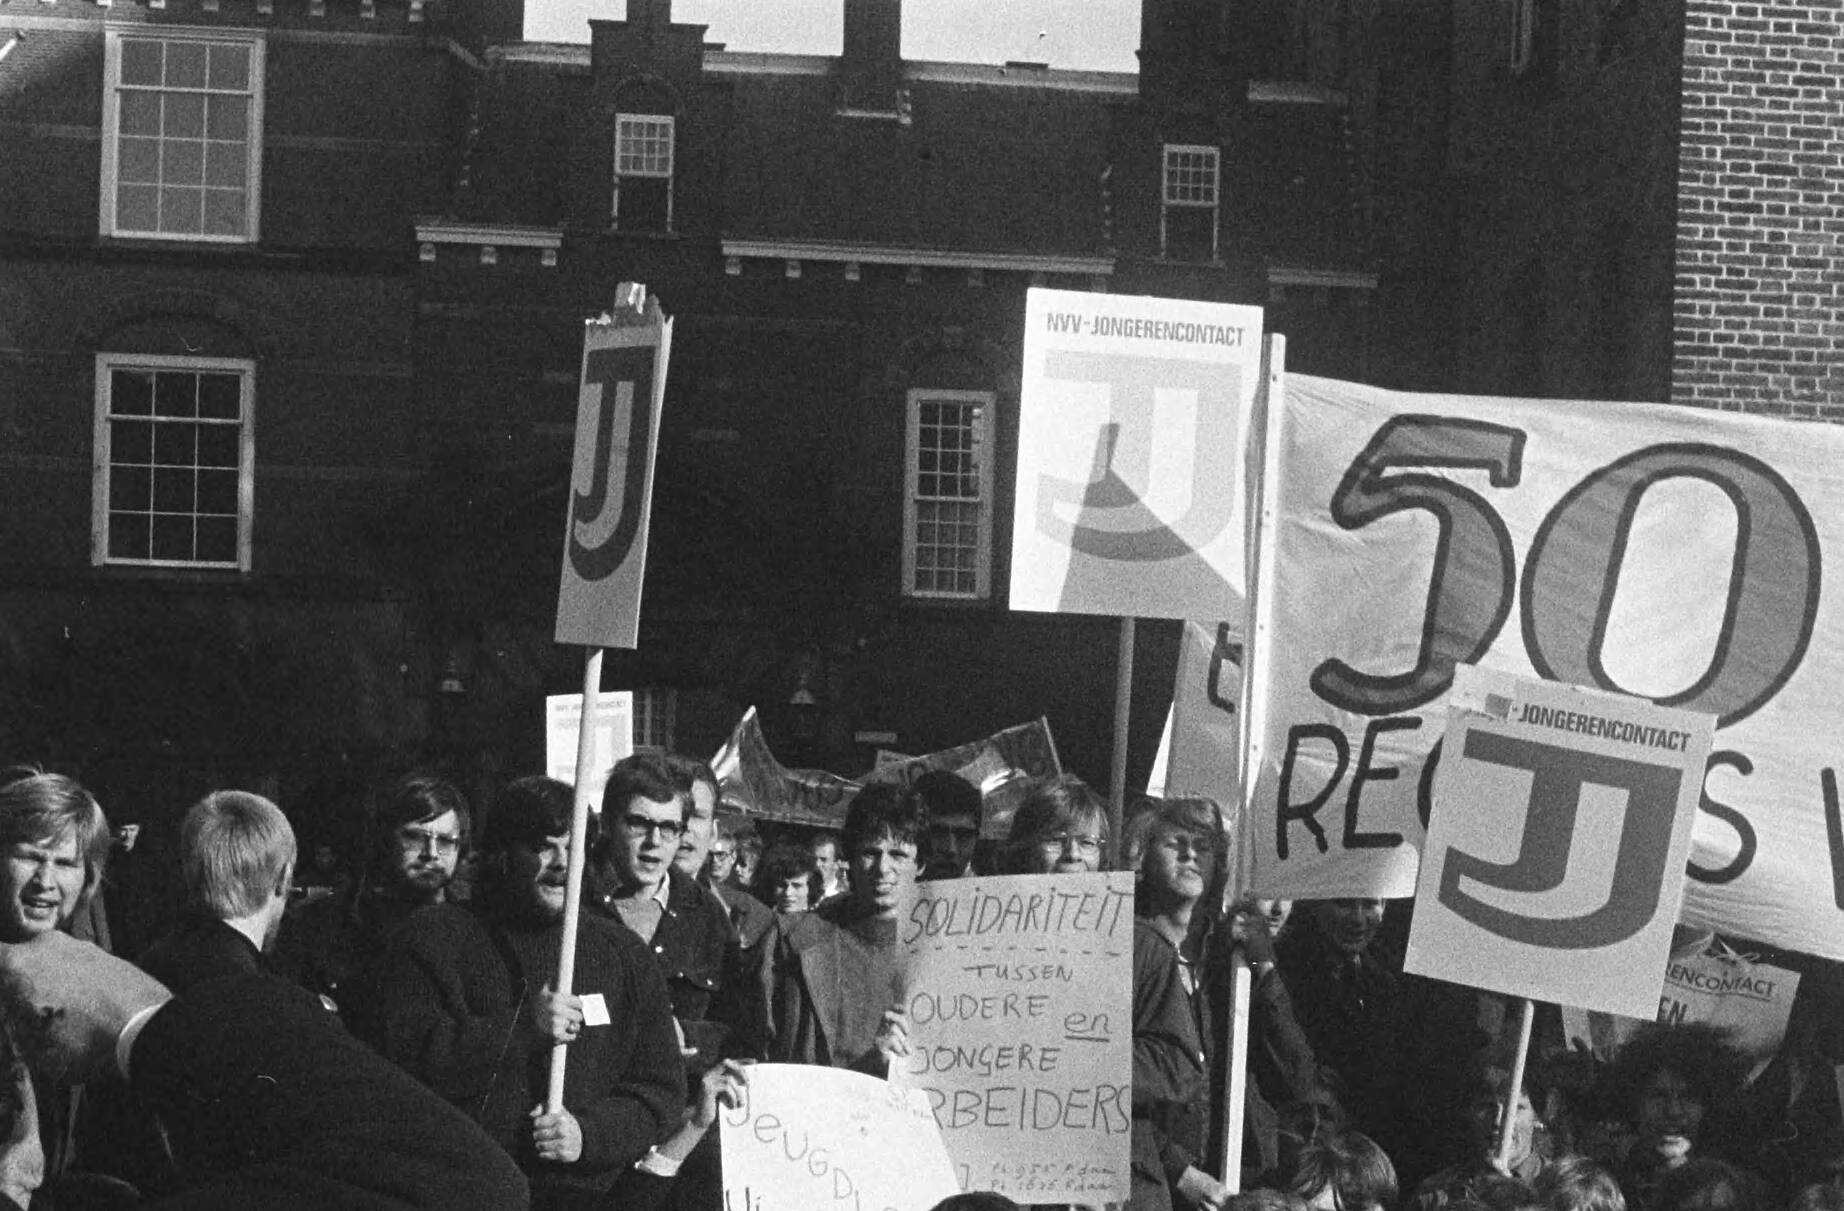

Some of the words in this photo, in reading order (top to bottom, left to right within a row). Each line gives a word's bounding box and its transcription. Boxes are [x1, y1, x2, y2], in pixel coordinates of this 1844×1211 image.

[1046, 312, 1245, 347] NVV-JONGERENCONTACT
[1308, 412, 1823, 732] 50
[962, 963, 1074, 984] TUSSEN
[909, 993, 1051, 1026] OUDERE
[1064, 1008, 1112, 1036] en
[909, 1045, 1061, 1077] JONGERE
[922, 1084, 1131, 1135] RBEIDERS
